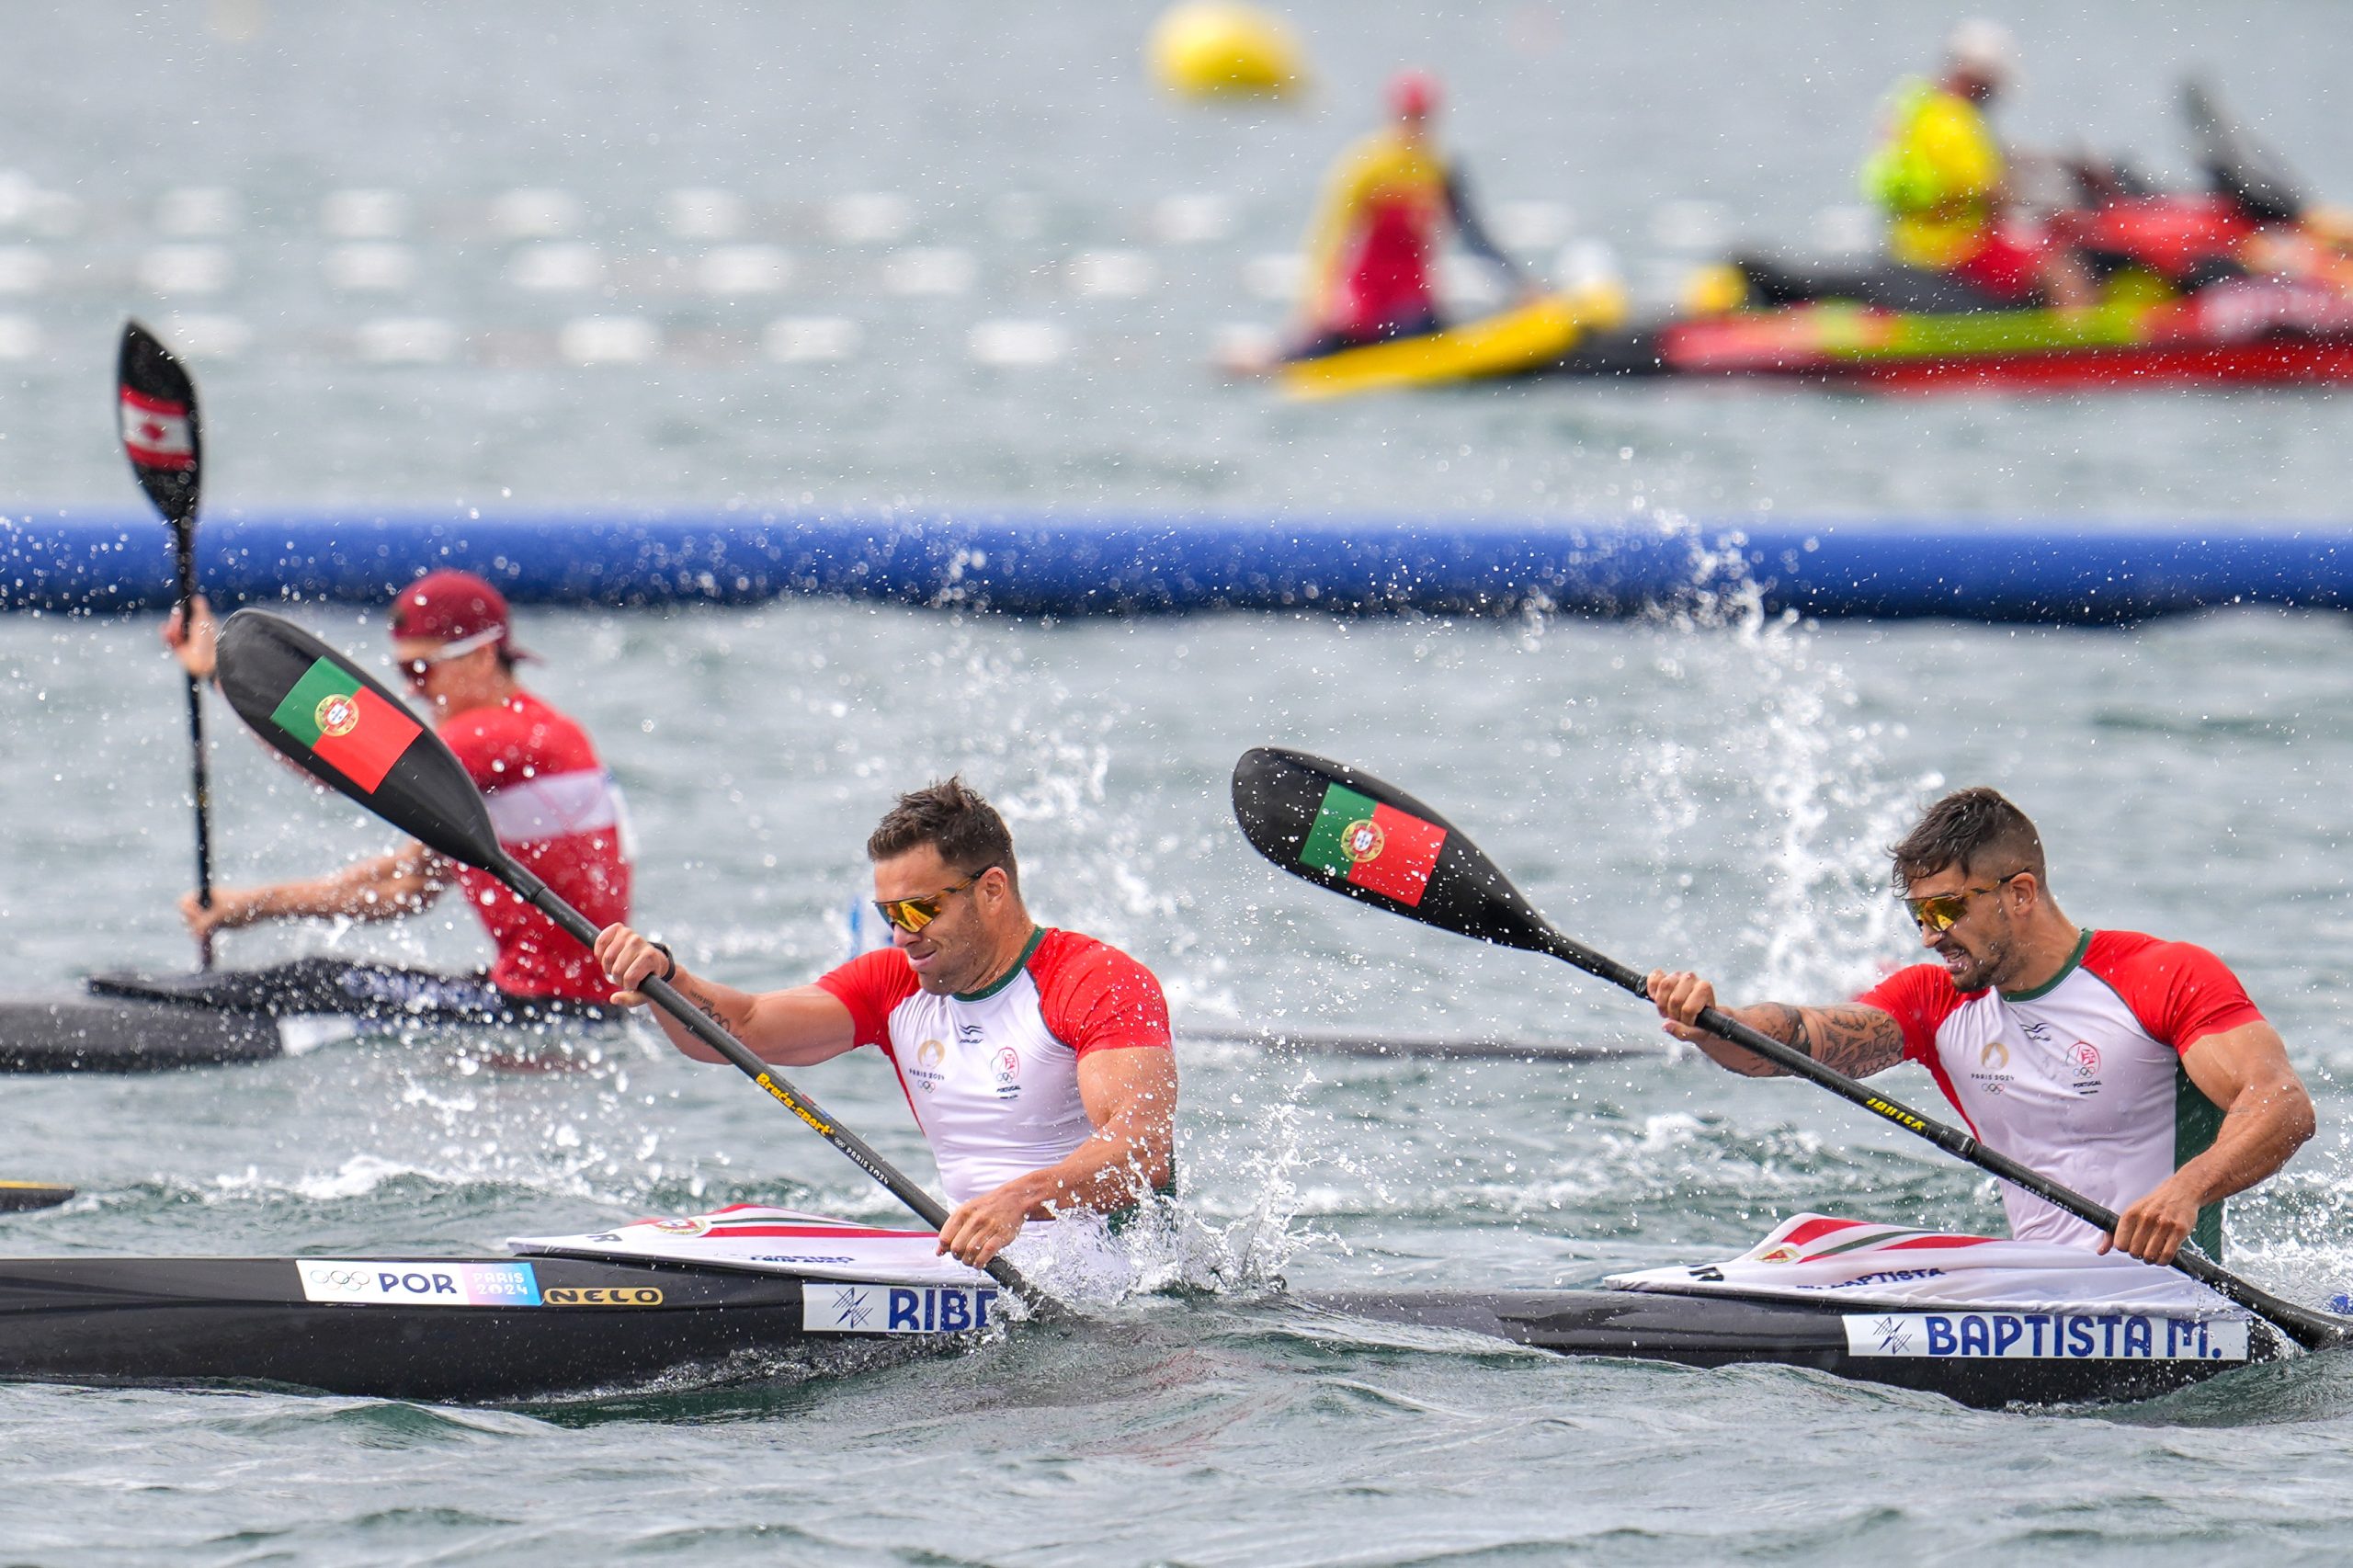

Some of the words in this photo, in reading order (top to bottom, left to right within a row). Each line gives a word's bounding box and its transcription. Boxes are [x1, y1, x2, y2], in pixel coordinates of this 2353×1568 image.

[1971, 1073, 1993, 1081] PARIS
[846, 1146, 869, 1168] PARIS
[868, 1164, 890, 1185] 2024
[2023, 1184, 2051, 1200] PARIS
[378, 1273, 458, 1294] POR
[472, 1272, 525, 1284] PARIS
[476, 1283, 529, 1295] 2024
[550, 1290, 659, 1303] NELO
[1925, 1314, 2153, 1358] BAPTISTA
[2166, 1317, 2222, 1359] M.
